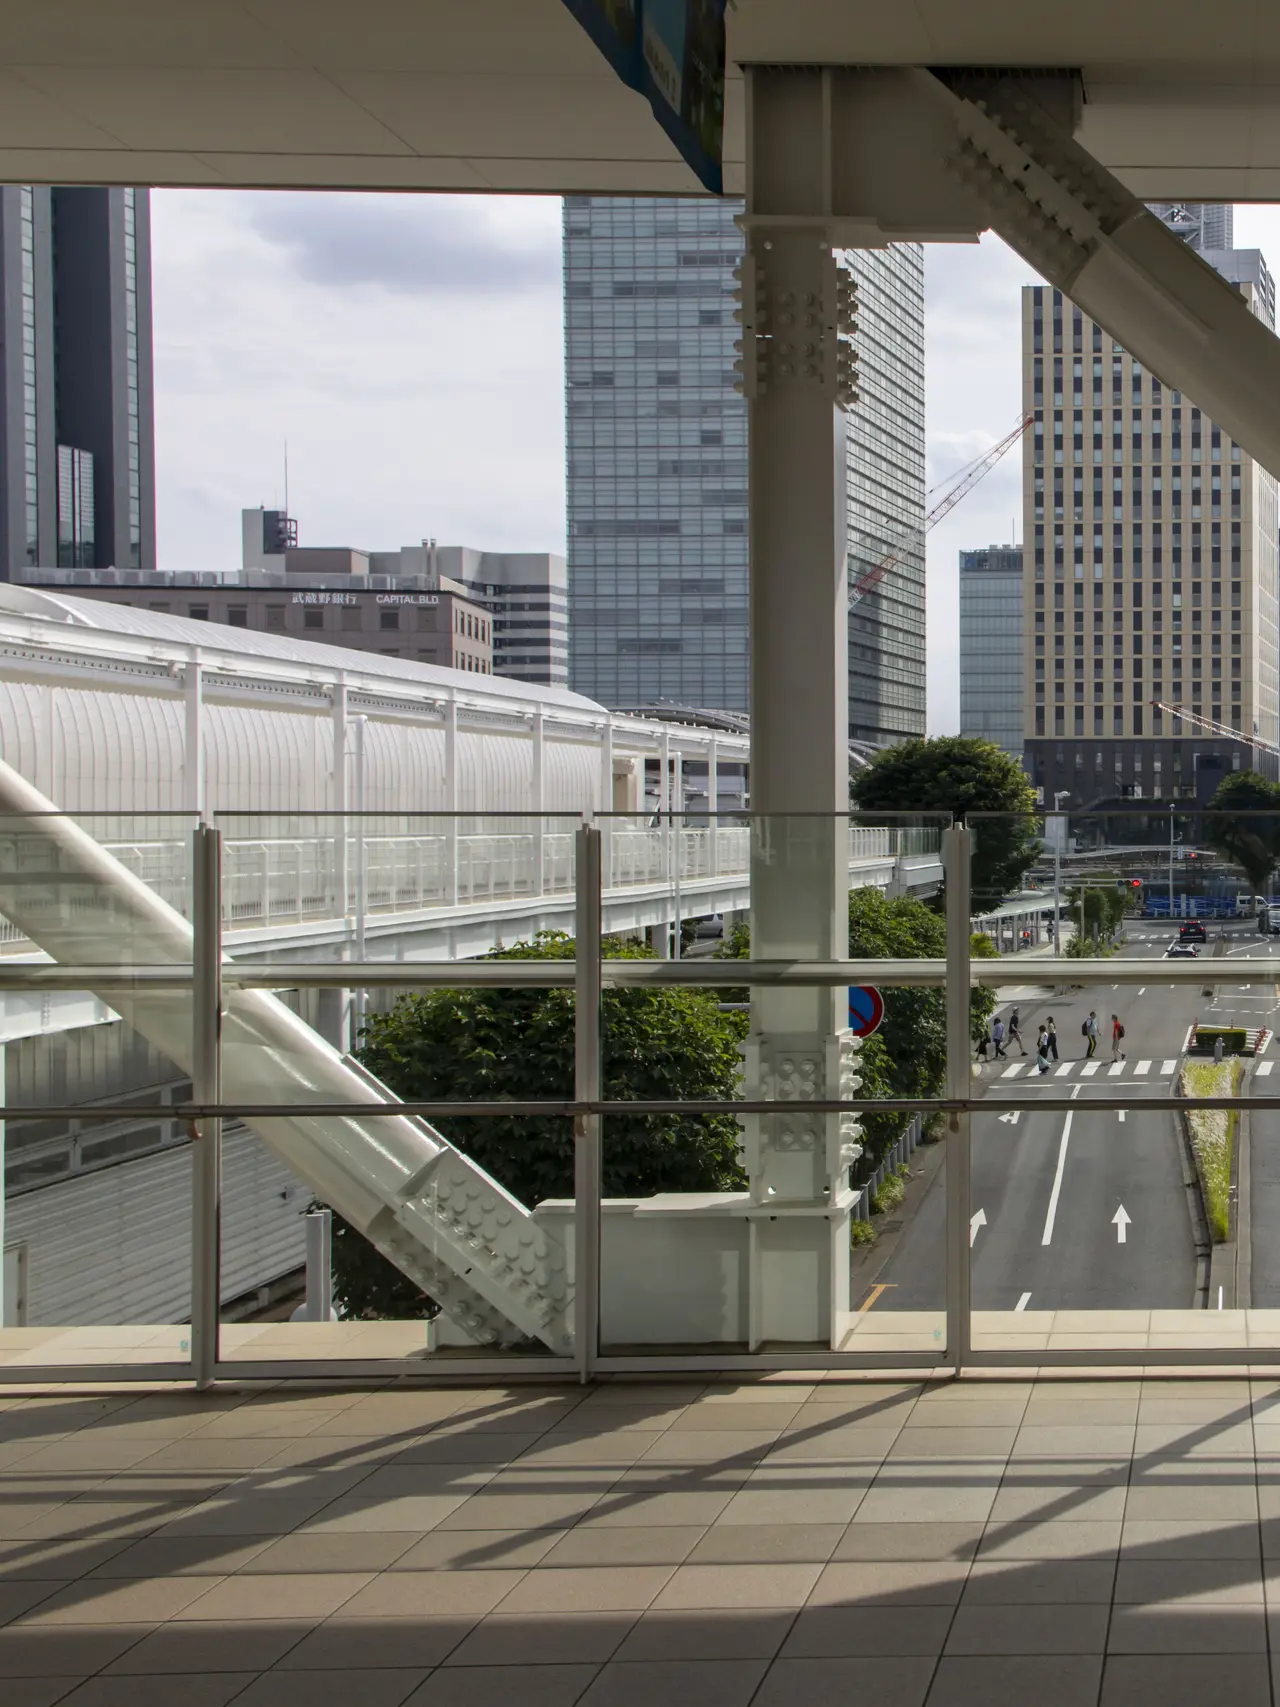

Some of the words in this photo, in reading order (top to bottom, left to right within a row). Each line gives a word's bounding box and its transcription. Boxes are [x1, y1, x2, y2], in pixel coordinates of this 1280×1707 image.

[292, 592, 357, 604] 武蔵野銀行
